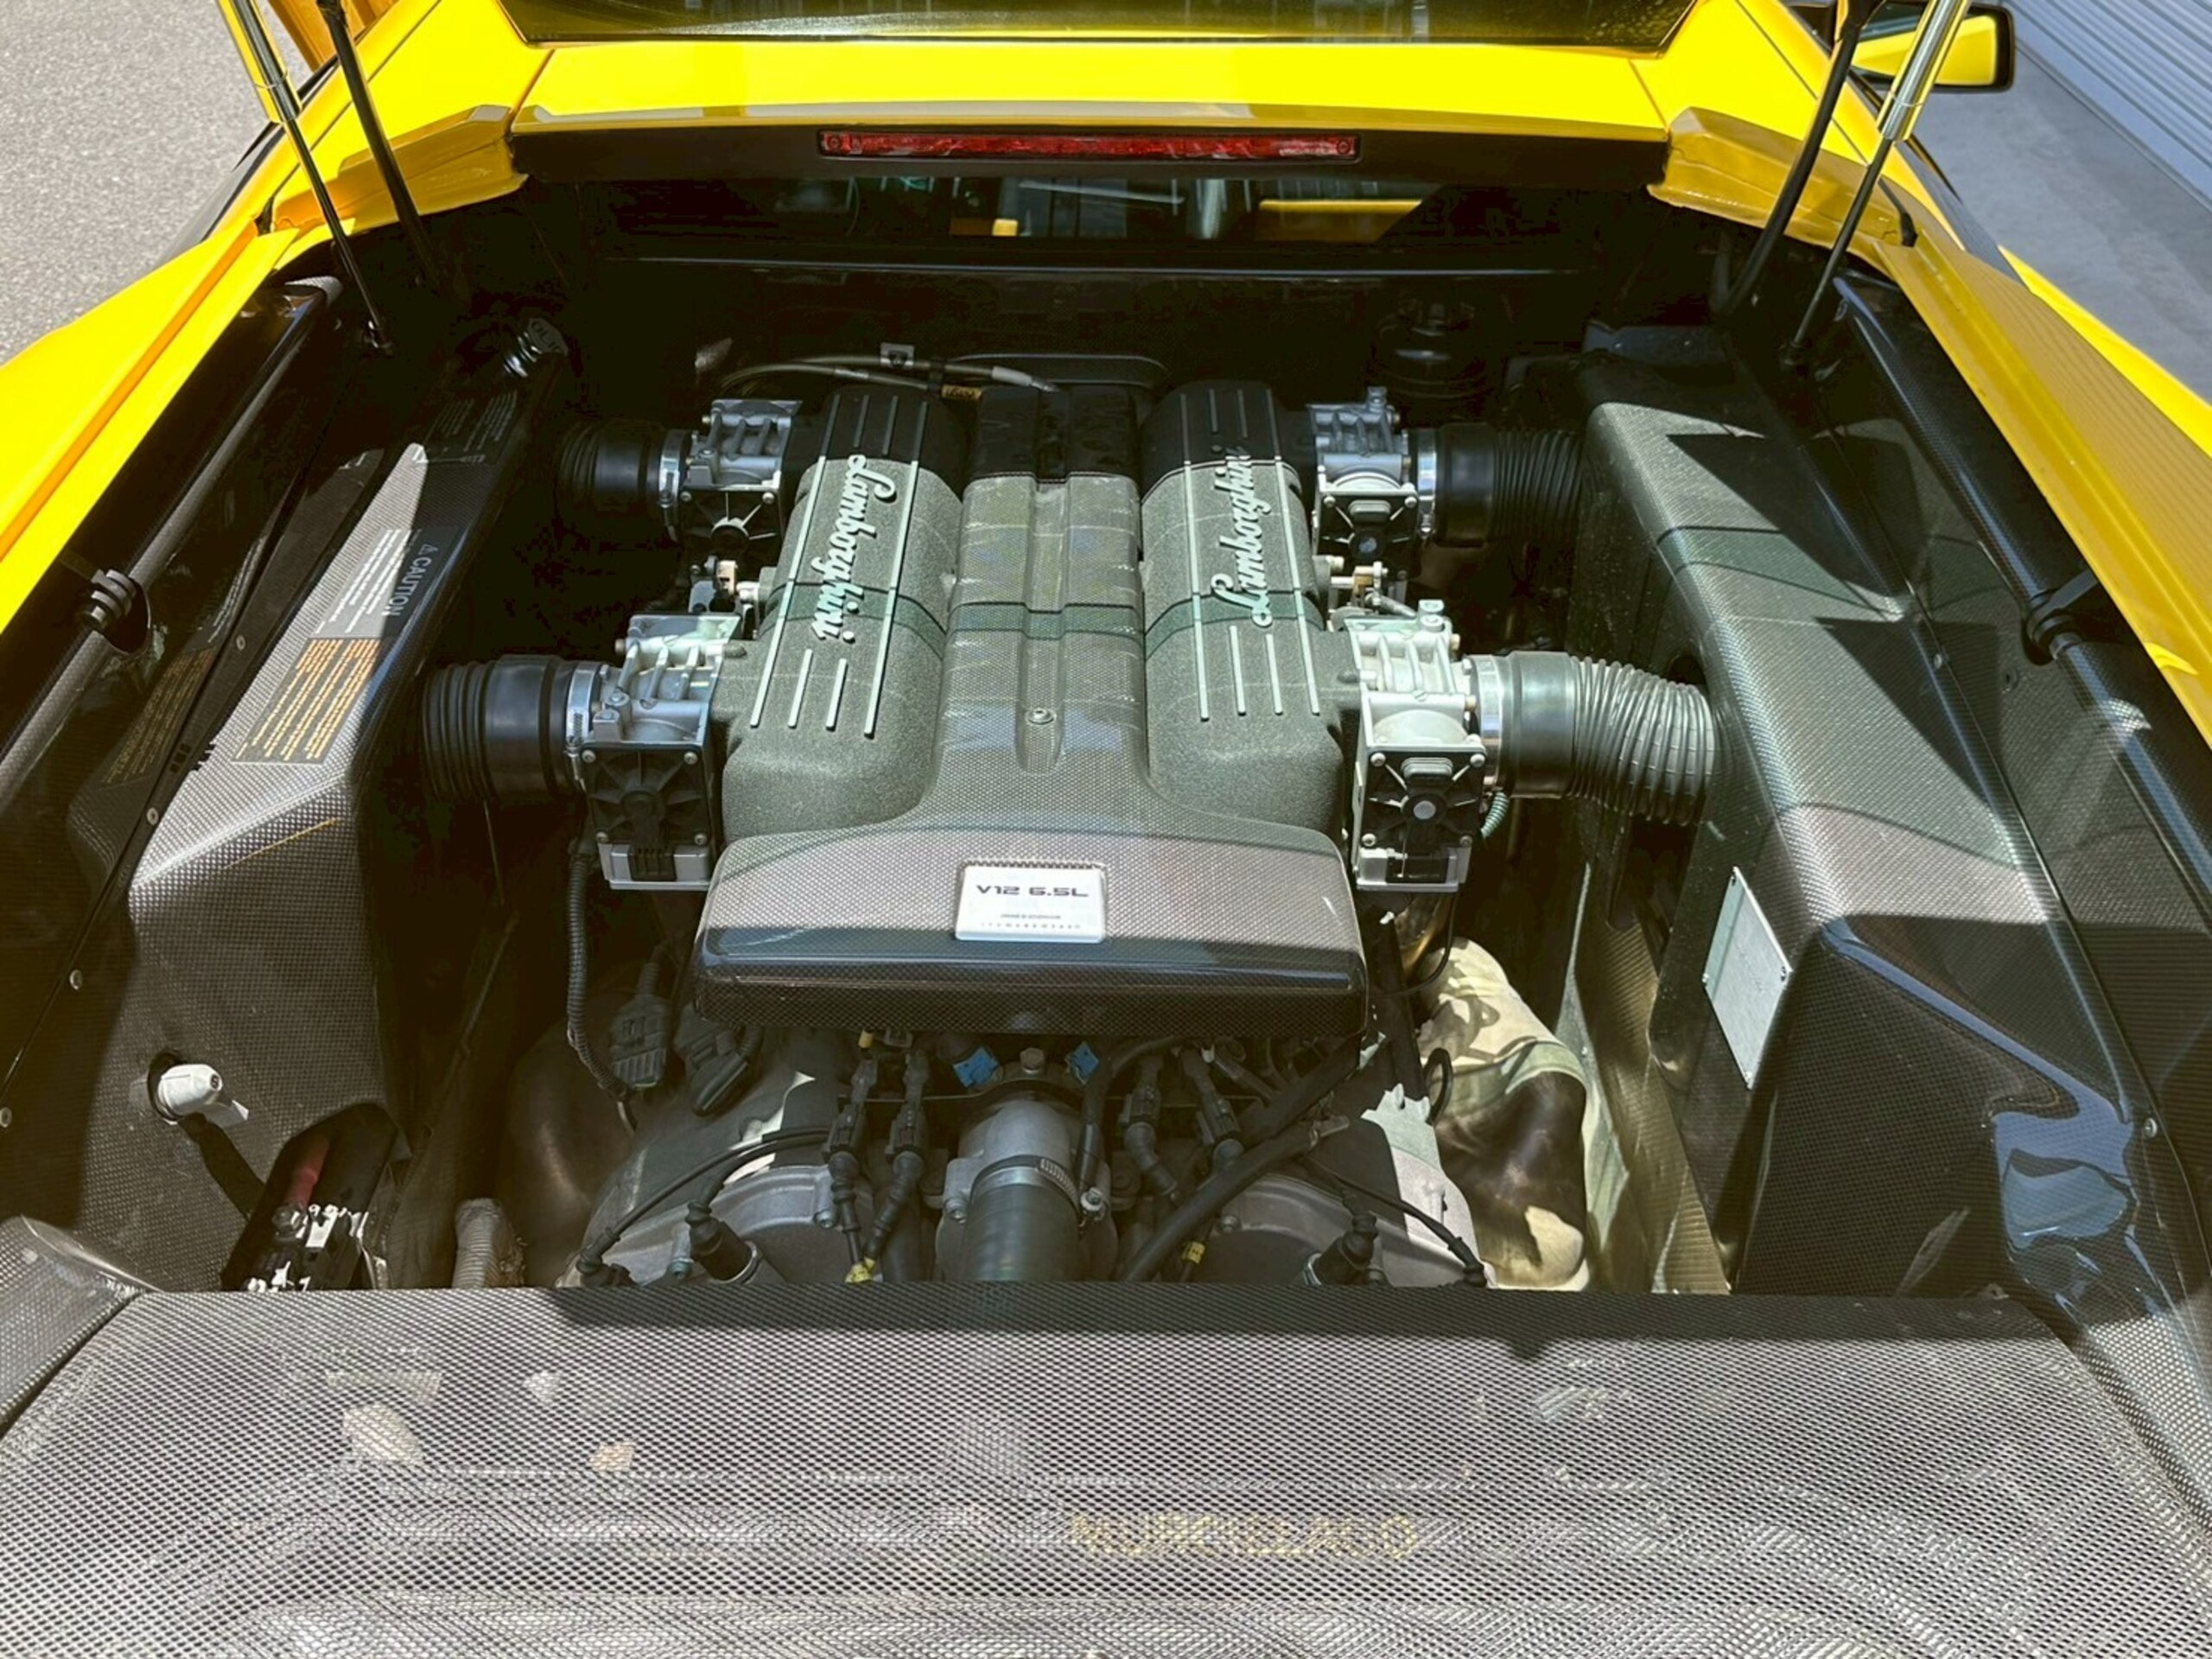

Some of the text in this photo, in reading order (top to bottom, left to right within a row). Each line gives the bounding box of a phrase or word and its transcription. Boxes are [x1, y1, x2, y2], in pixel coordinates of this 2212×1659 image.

[381, 556, 432, 616] CAUTION
[810, 454, 896, 642] Lamborghini
[1211, 445, 1273, 627] Lamborghini
[976, 885, 1089, 897] V12 6.5L
